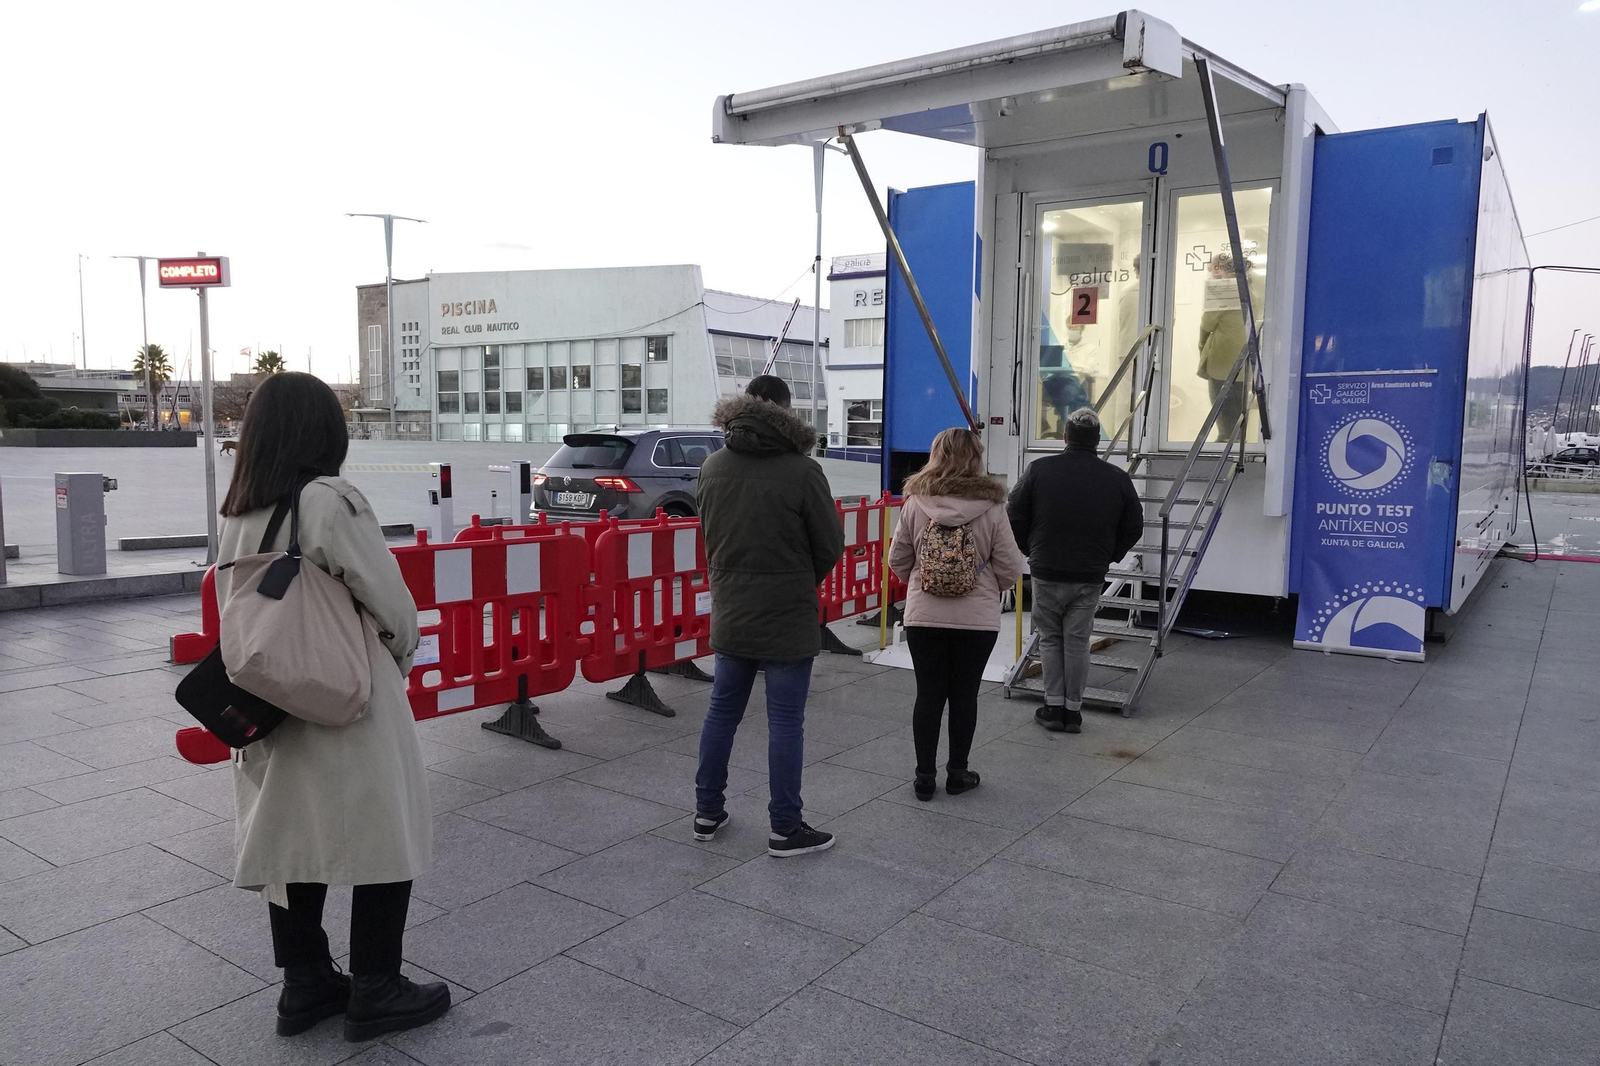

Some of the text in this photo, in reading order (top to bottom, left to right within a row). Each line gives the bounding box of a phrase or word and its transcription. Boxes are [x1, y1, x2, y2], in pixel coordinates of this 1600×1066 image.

[1148, 142, 1169, 175] Q
[160, 264, 218, 278] COMPLETO
[1213, 261, 1225, 271] de
[441, 299, 497, 317] PISCINA
[1077, 293, 1091, 316] 2
[441, 321, 519, 335] REAL CLUB NAUTICO
[1337, 382, 1367, 390] SERVIZO
[1316, 503, 1414, 517] PUNTO TEST
[1318, 518, 1408, 534] ANTÍXENOS
[1321, 538, 1405, 549] XUNTA DE GALICIA
